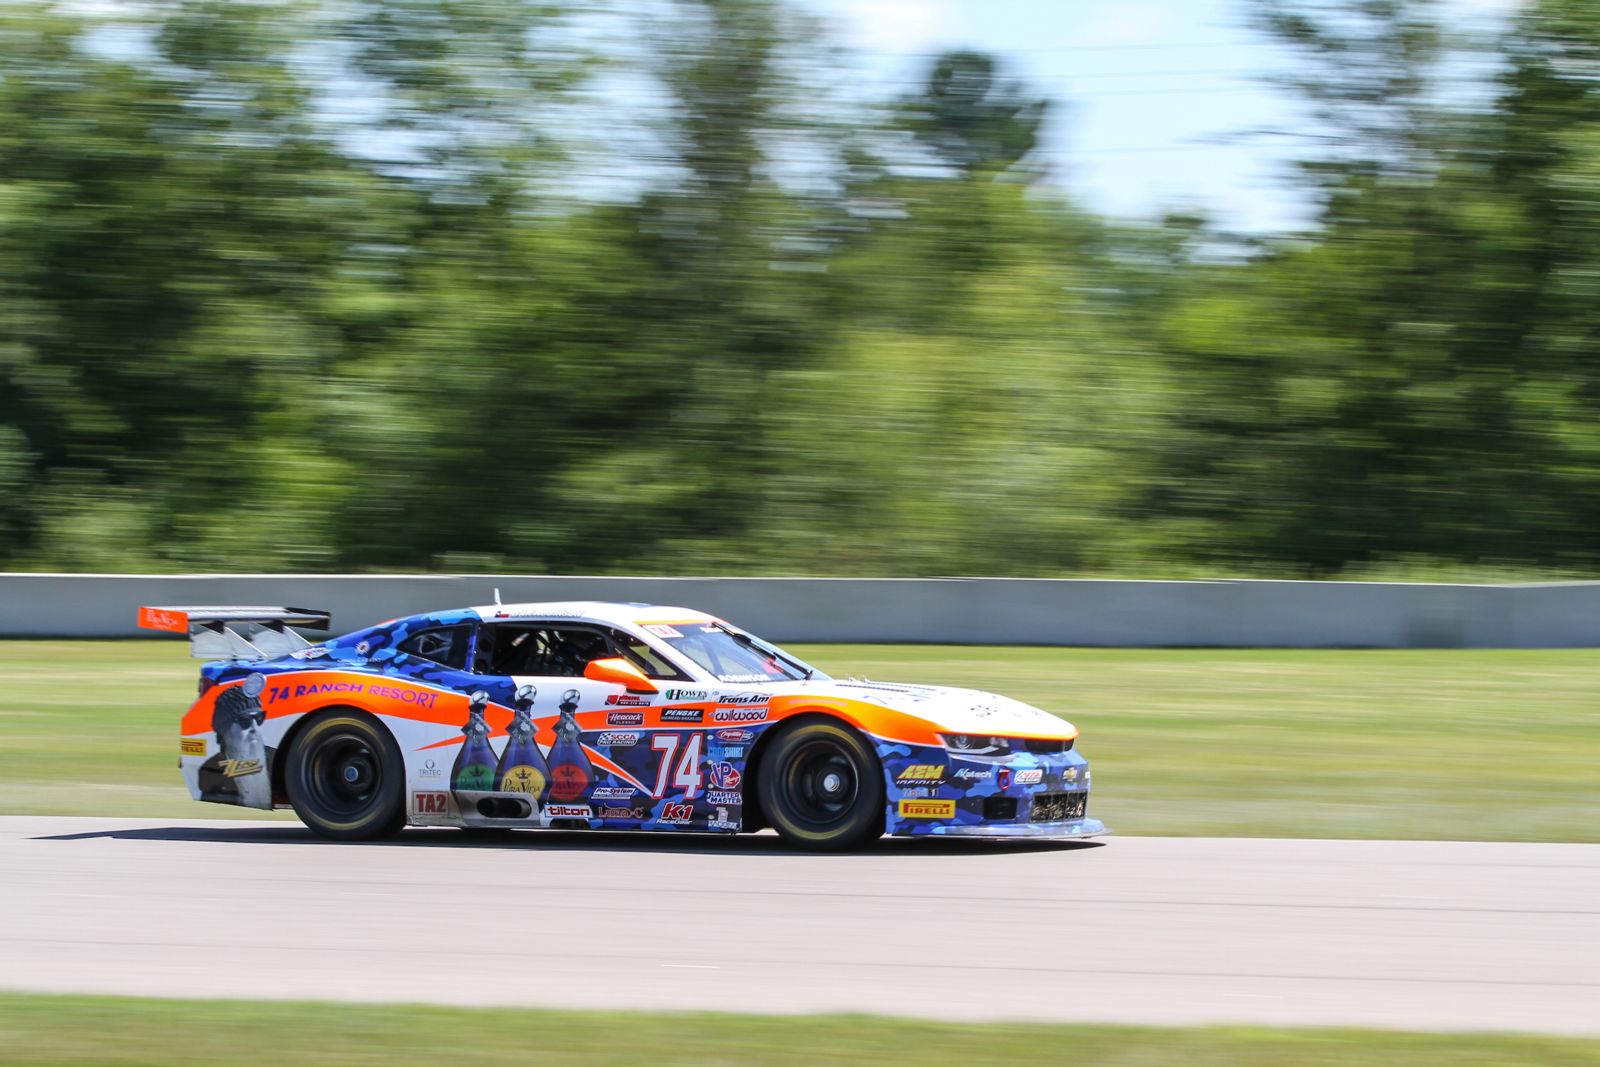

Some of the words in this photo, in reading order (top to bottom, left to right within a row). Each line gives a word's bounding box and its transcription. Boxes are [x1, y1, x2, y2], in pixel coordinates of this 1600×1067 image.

[268, 687, 290, 704] 74
[295, 683, 364, 697] RANCH
[368, 685, 439, 709] RESORT
[718, 695, 747, 704] Trans
[749, 694, 770, 703] Am
[665, 709, 700, 717] PENSKE
[715, 708, 768, 721] wilwood
[651, 731, 704, 800] 74
[897, 765, 945, 779] AEM
[711, 761, 733, 788] VP
[415, 794, 447, 813] TA2
[661, 801, 693, 820] K1
[903, 803, 951, 815] PIRELLI
[547, 806, 590, 816] tilton
